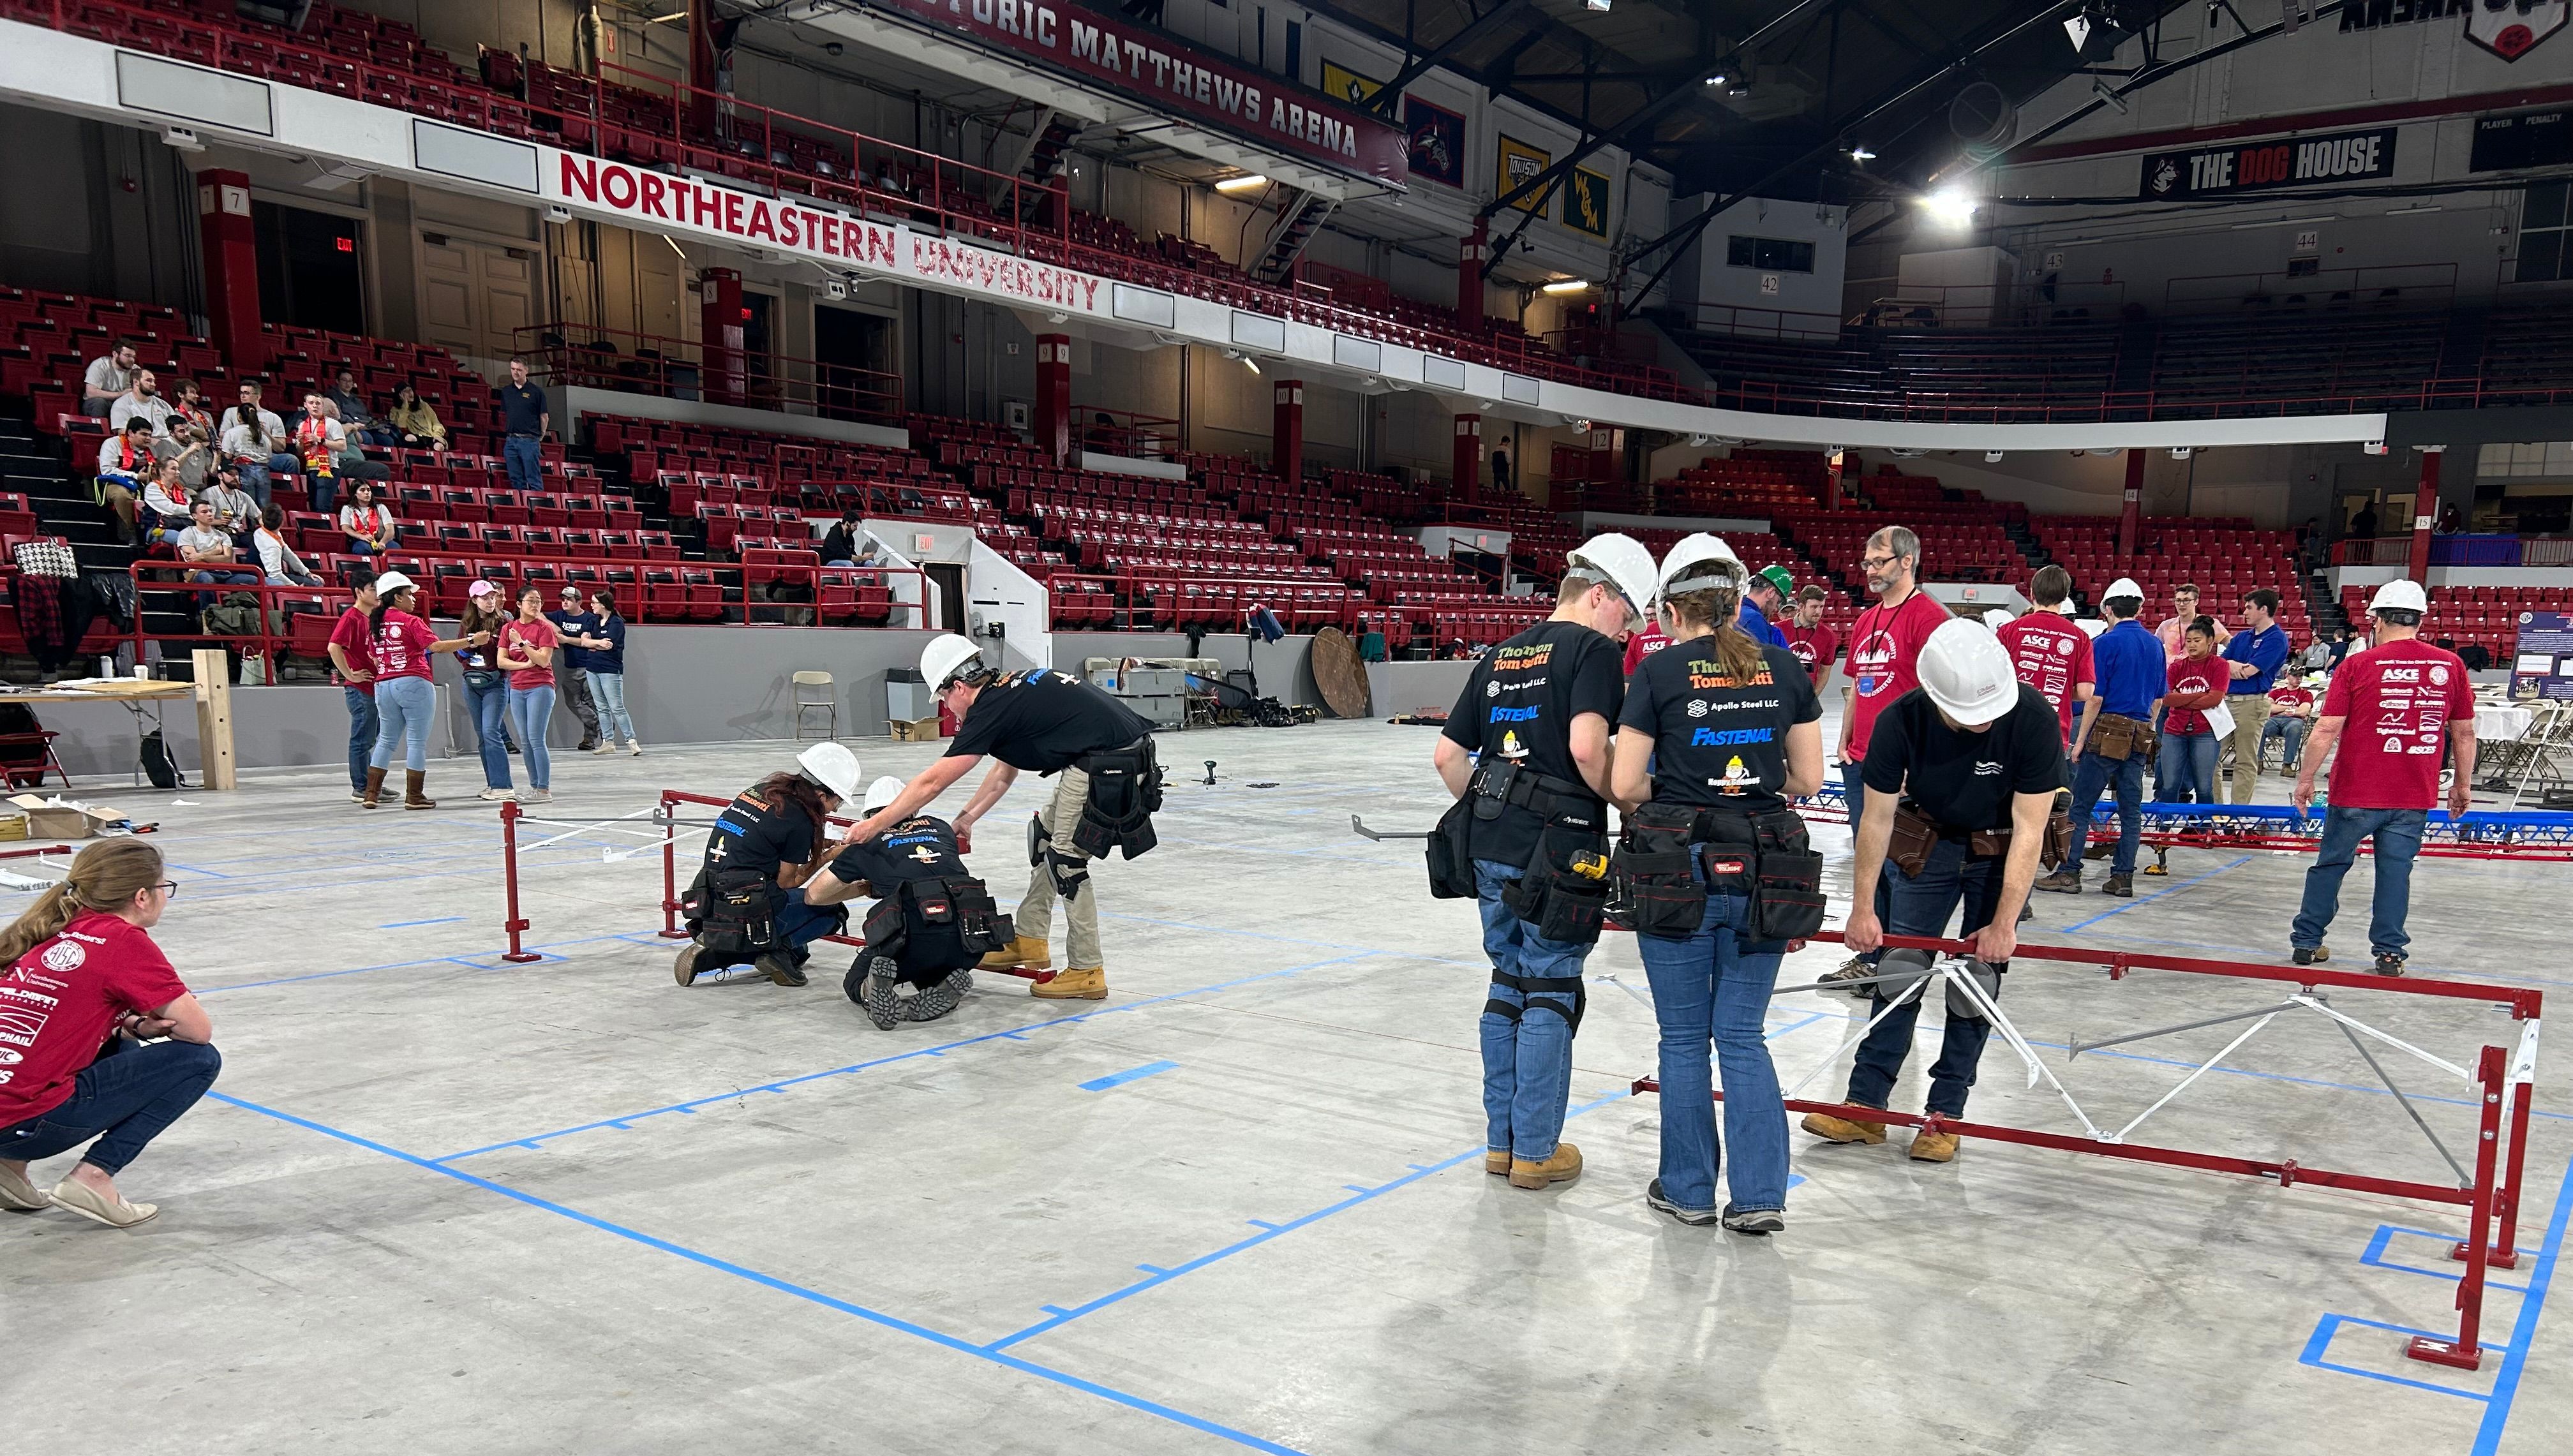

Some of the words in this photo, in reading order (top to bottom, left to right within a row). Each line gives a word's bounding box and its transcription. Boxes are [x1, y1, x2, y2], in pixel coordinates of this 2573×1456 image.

[930, 0, 1057, 48] ORIC
[1071, 19, 1260, 123] MATTHEWS
[1270, 96, 1357, 158] ARENA
[2482, 119, 2512, 129] PLAYER
[2525, 113, 2562, 125] PENALTY
[1509, 154, 1542, 177] TOWSON
[2190, 152, 2234, 190] THE
[2238, 145, 2290, 185] DOG
[2295, 135, 2381, 179] HOUSE
[230, 193, 239, 209] 7
[560, 153, 895, 267] NORTHEASTERN
[913, 237, 1099, 311] UNIVERSITY
[336, 237, 352, 251] EXIT
[2299, 234, 2316, 248] 44
[2047, 255, 2063, 267] 43
[1762, 277, 1777, 292] 42
[707, 286, 713, 299] 8
[1042, 346, 1048, 358] 9
[1060, 346, 1066, 358] 9
[1279, 391, 1286, 401] 10
[1294, 392, 1301, 401] 10
[1595, 433, 1607, 447] 12
[2419, 519, 2428, 527] 15
[920, 537, 933, 550] EXIT
[1642, 641, 1667, 651] ASCE
[2021, 634, 2050, 648] ASCE
[1689, 671, 1774, 690] Tomaetti
[2381, 669, 2419, 680] ASCE
[1533, 678, 1547, 686] LLC
[1711, 702, 1740, 711] Apollo
[1741, 700, 1763, 709] Steel
[1764, 699, 1780, 708] LLC
[1691, 727, 1773, 746] FASTENAL
[50, 946, 77, 965] AISC
